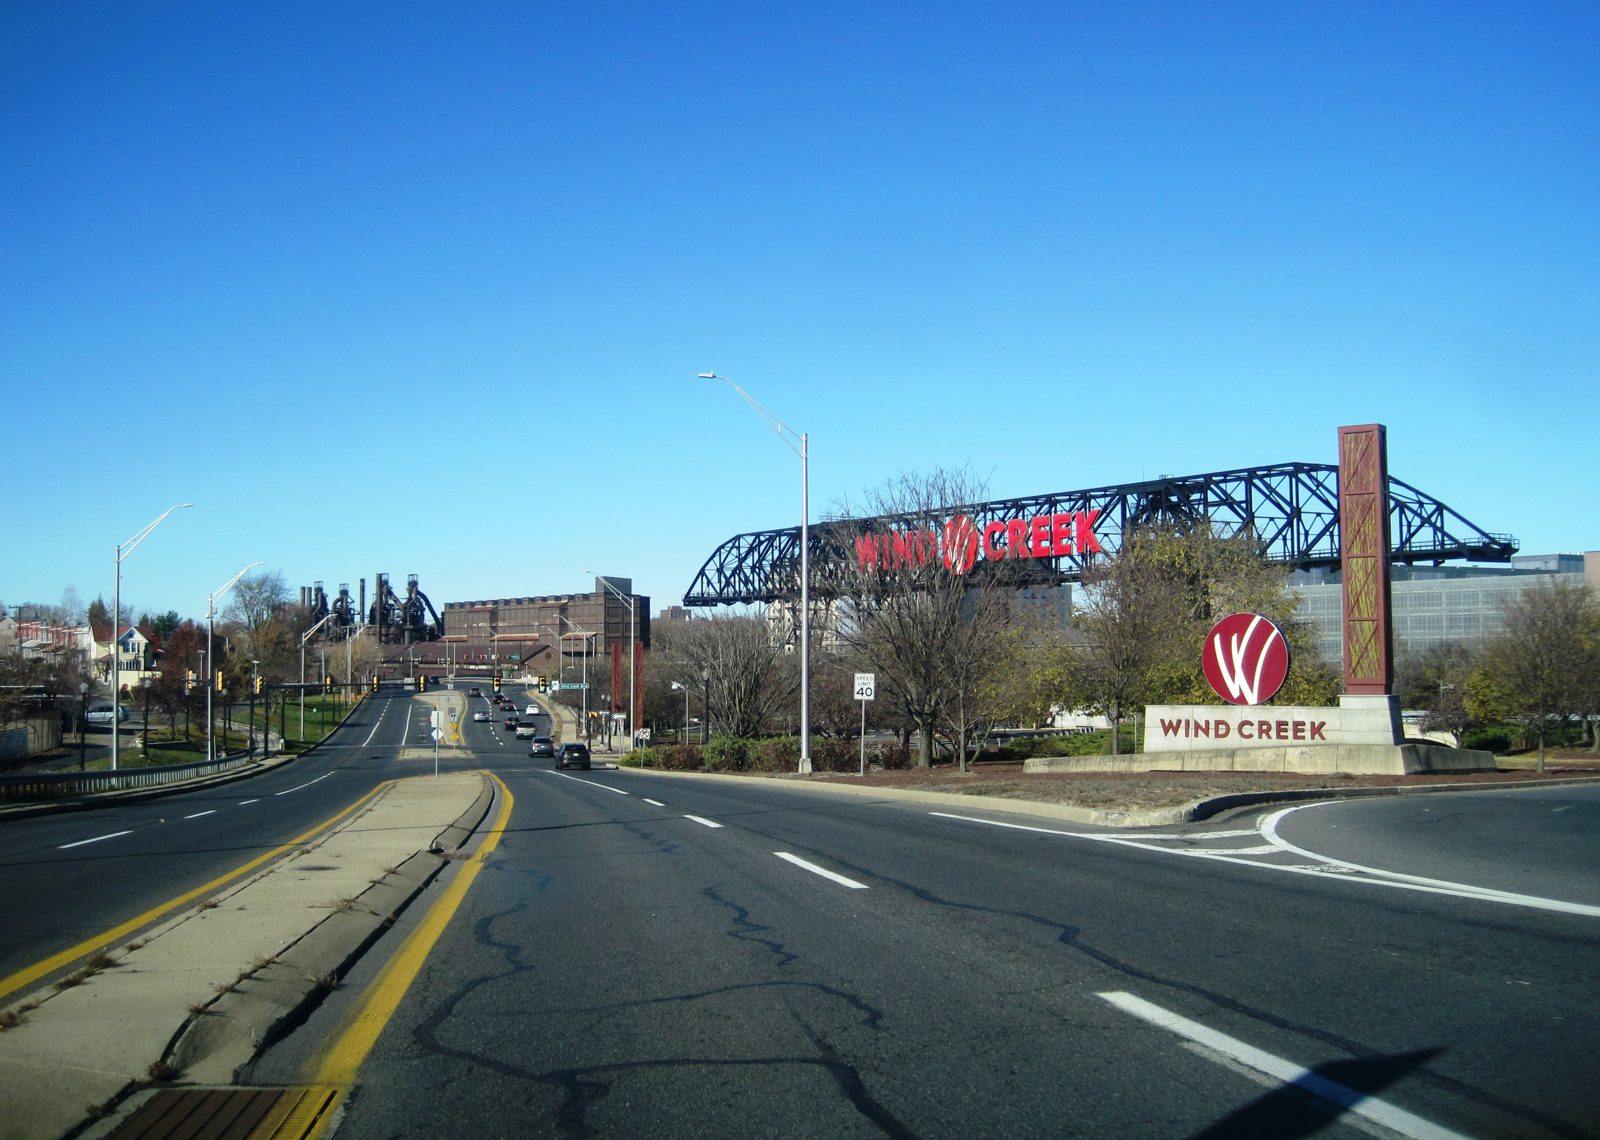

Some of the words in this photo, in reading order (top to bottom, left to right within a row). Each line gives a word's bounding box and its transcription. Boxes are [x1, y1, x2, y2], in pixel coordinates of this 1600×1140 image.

[855, 530, 938, 575] WIND
[983, 510, 1101, 561] CREEK
[856, 687, 872, 697] 40
[1160, 719, 1231, 739] WIND
[1237, 719, 1327, 741] CREEK
